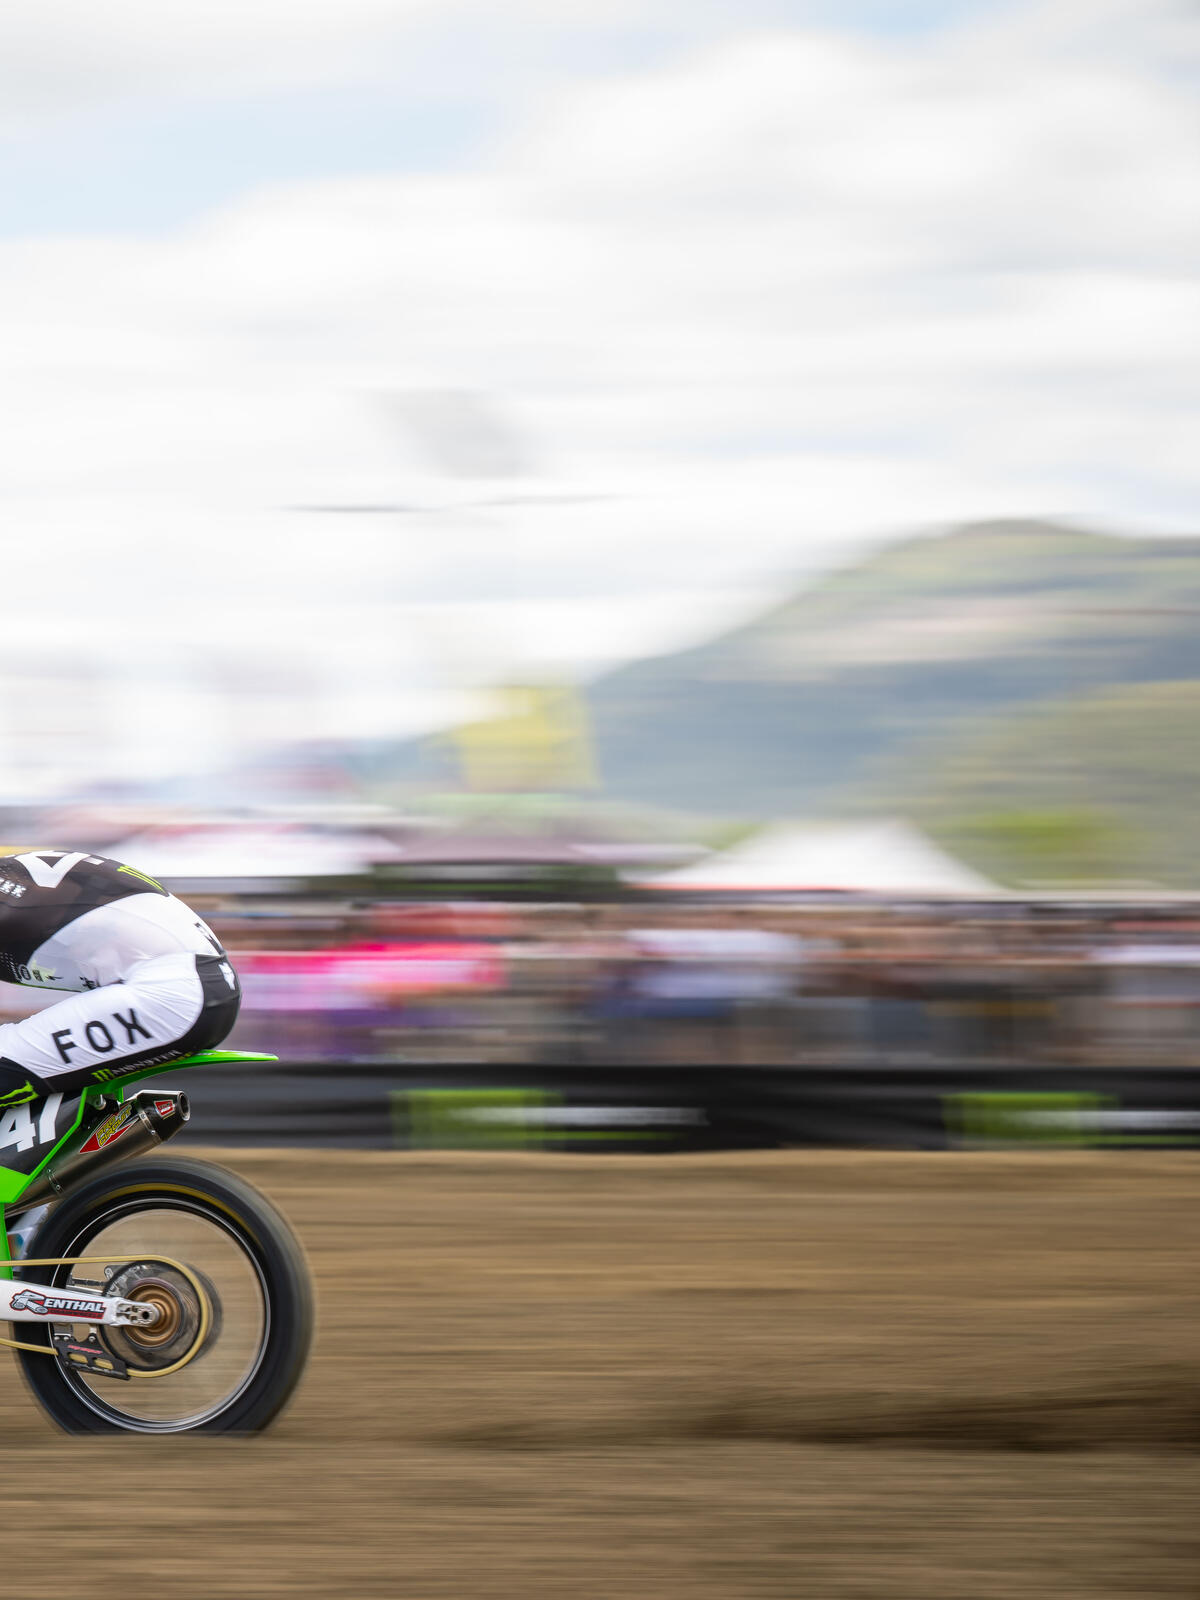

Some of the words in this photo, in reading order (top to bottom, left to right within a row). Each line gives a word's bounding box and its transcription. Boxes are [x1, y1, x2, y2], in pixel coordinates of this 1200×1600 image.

[52, 1008, 154, 1064] FOX
[96, 1115, 117, 1138] PRO
[100, 1103, 132, 1147] CIRCUIT
